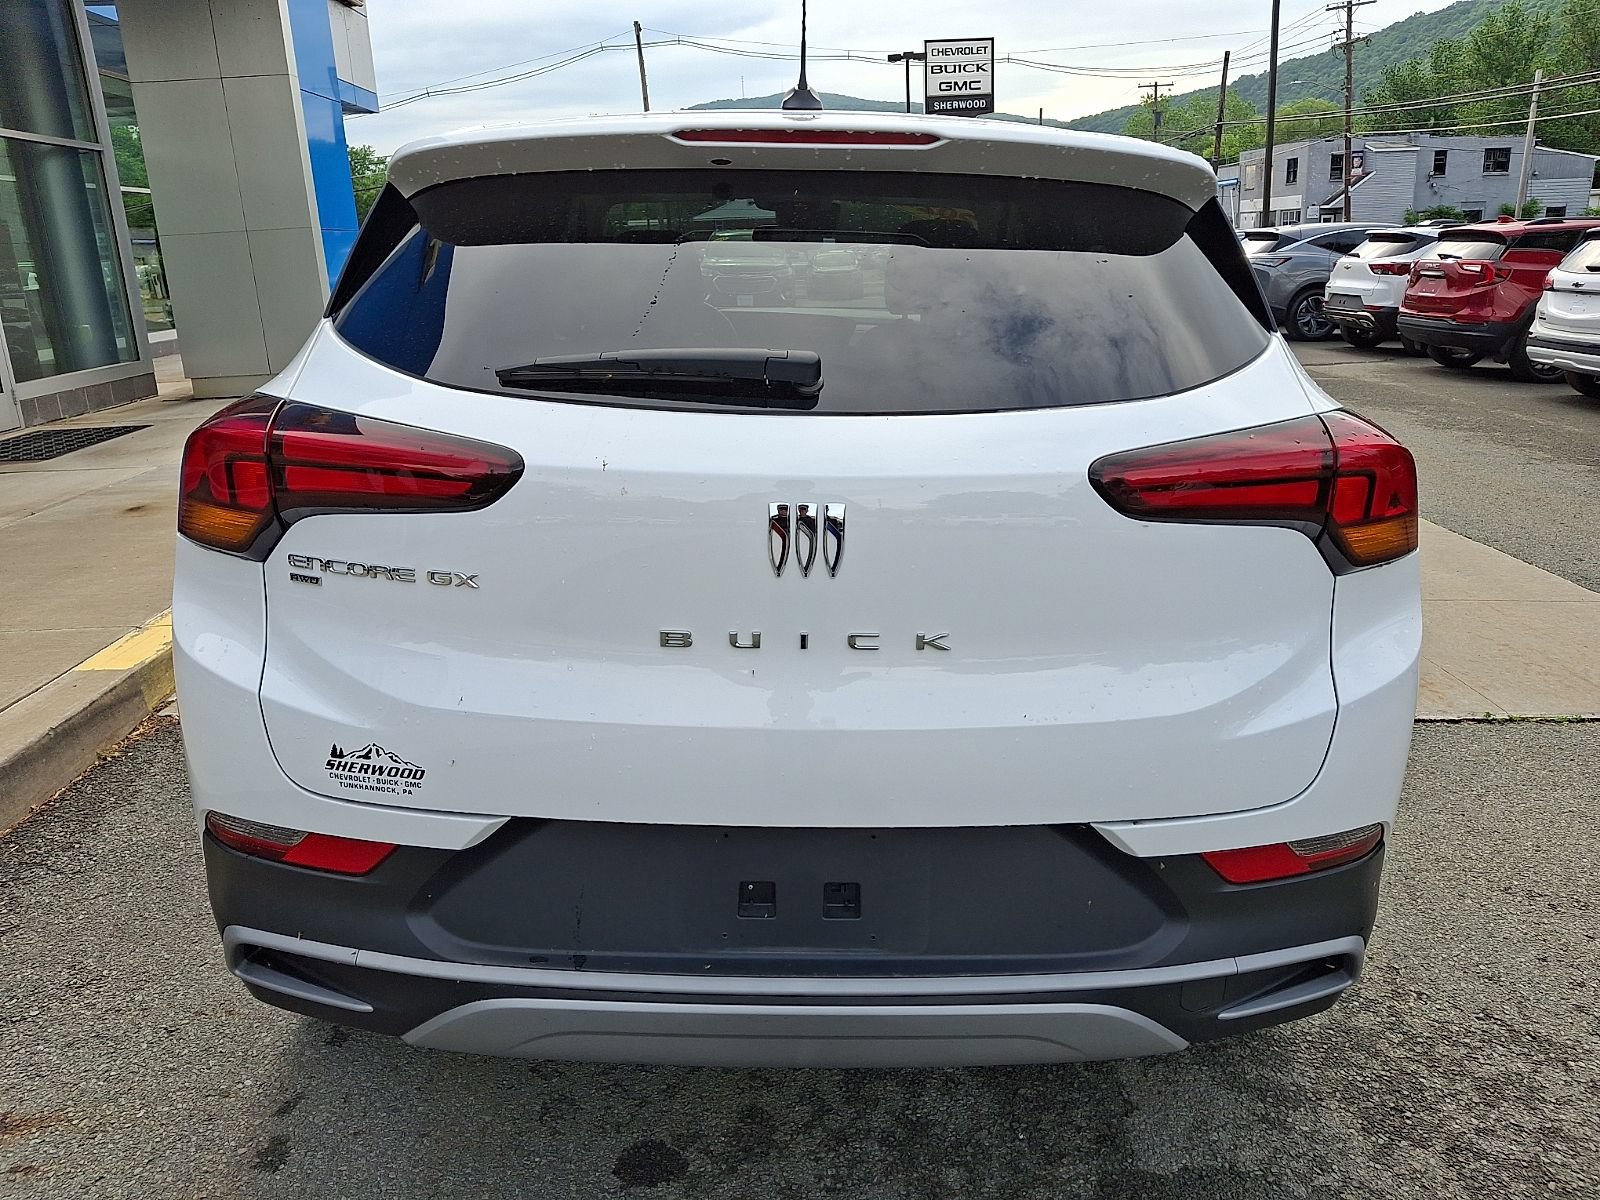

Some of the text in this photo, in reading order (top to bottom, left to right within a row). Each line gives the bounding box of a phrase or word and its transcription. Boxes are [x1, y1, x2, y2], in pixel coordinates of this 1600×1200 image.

[931, 46, 989, 57] CHEVROLET
[930, 63, 989, 74] BUICK
[938, 80, 982, 92] GMC
[933, 99, 987, 110] SHERWOOD
[287, 553, 480, 589] ENCORE GX
[289, 572, 323, 587] AWD
[659, 629, 952, 651] BUICK
[324, 758, 426, 781] SHERWOOD
[329, 772, 422, 789] CHEVROLET BUICK GMC
[338, 781, 413, 796] TUNKHANNOCK, PA
